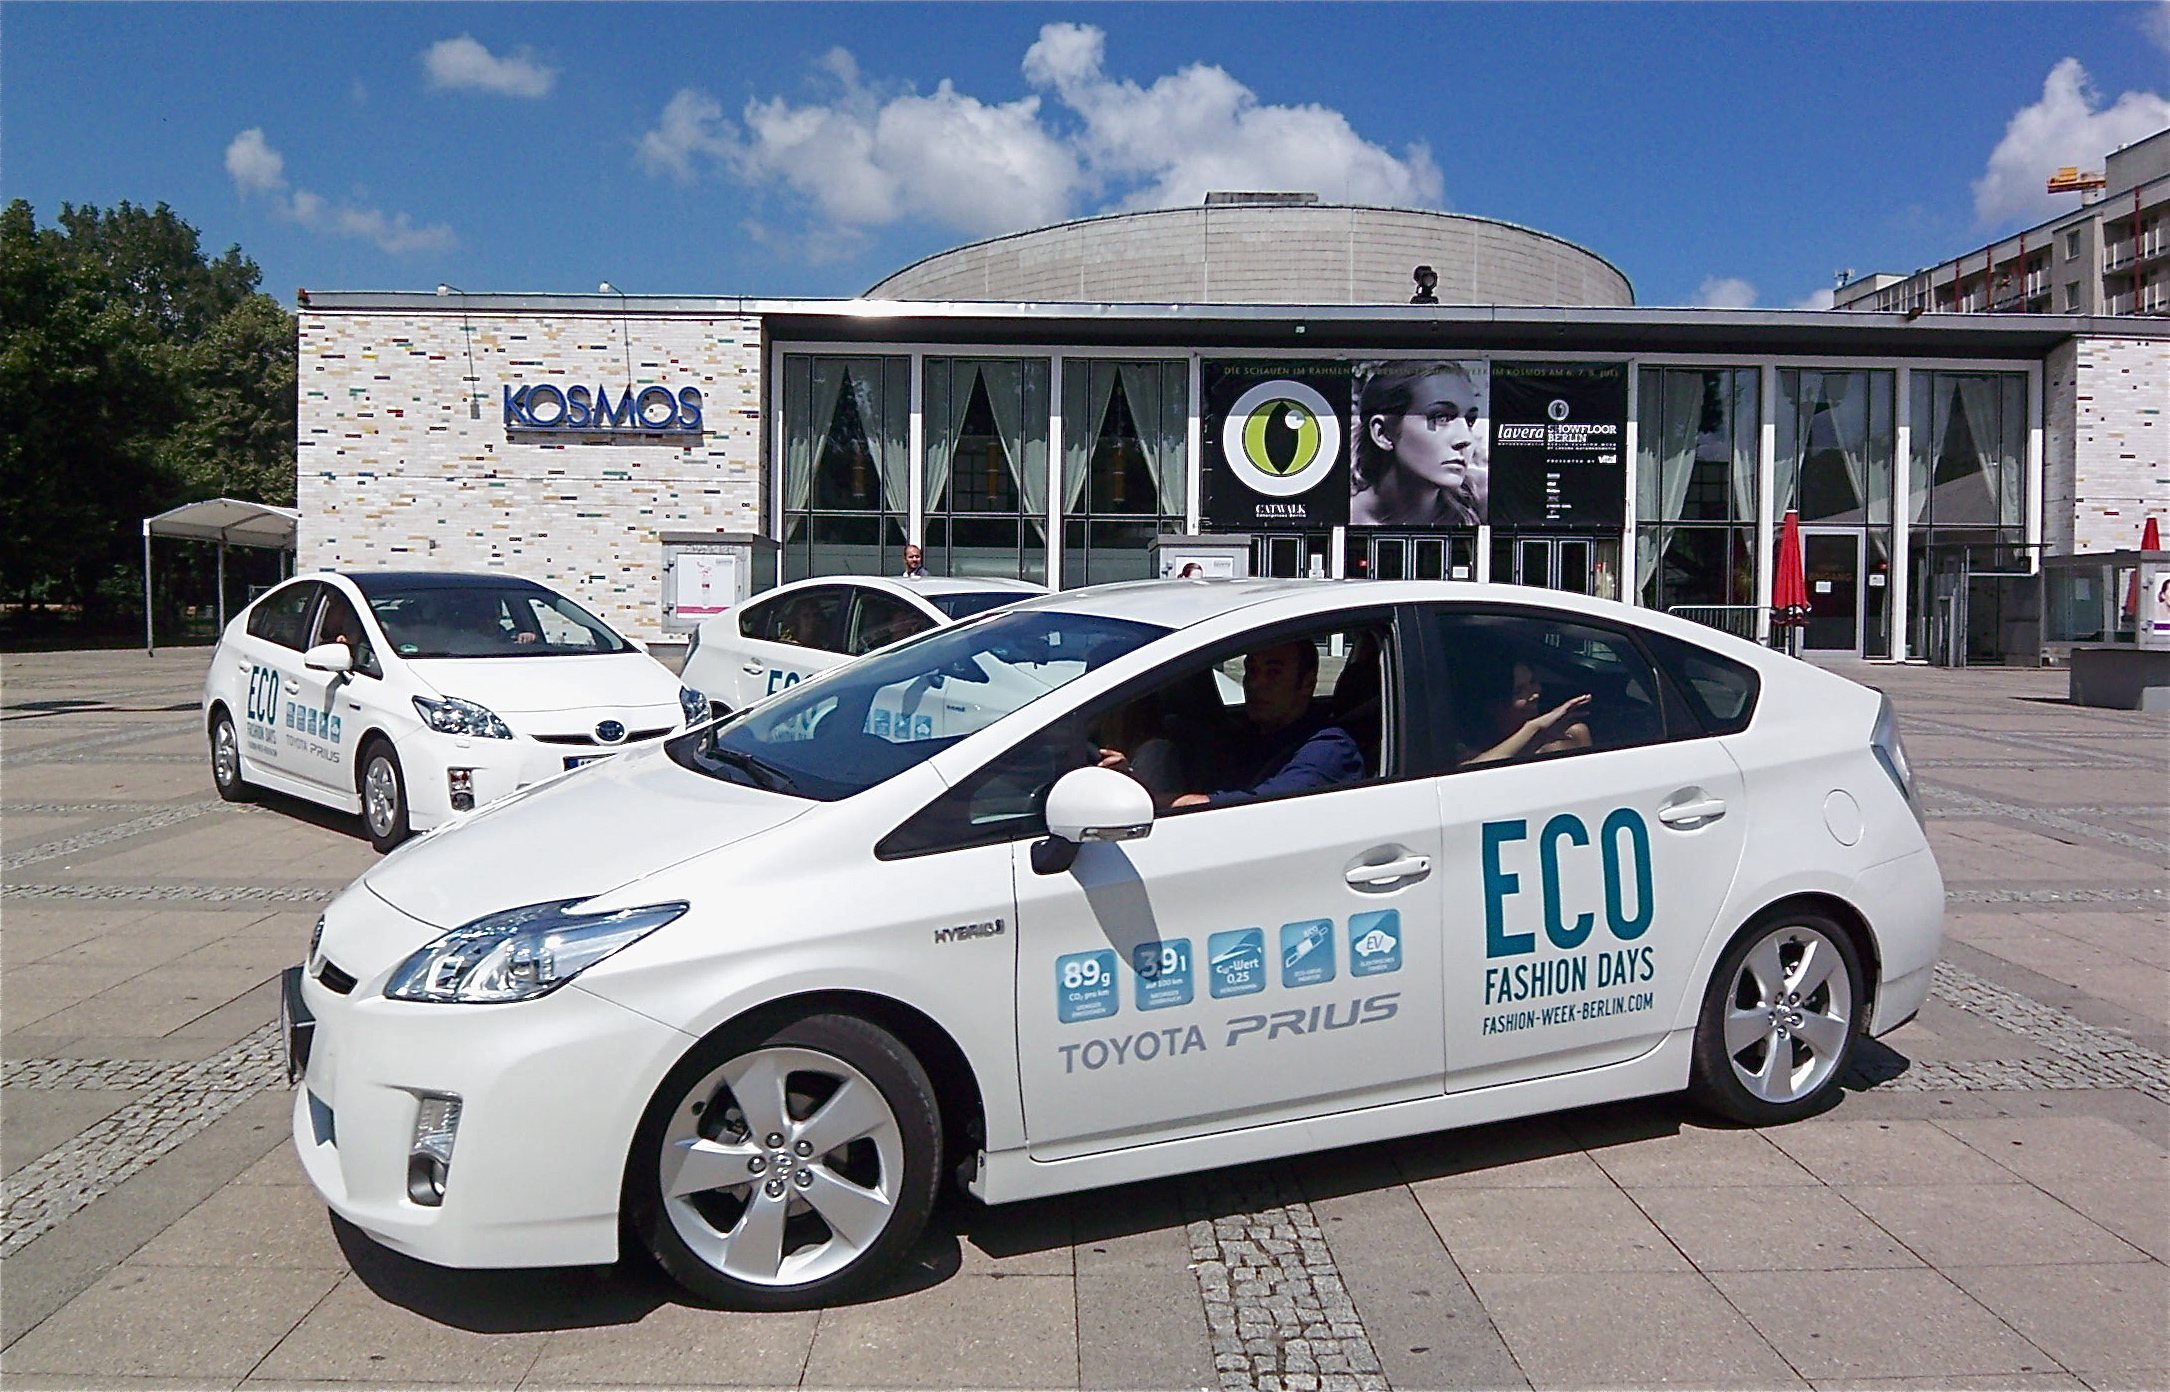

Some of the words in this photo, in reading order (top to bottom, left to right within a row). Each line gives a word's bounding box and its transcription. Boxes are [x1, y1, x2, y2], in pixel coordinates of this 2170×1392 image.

[1224, 366, 1239, 375] DIE
[1244, 366, 1289, 375] SCHAUEN
[1293, 366, 1305, 375] IM
[1309, 366, 1350, 375] RAHMEN
[1507, 367, 1546, 377] KOSMOS
[503, 383, 703, 428] KOSMOS
[1498, 423, 1545, 439] lavera
[1547, 424, 1617, 435] SHOWFLOOR
[1547, 434, 1588, 442] BERLIN
[1255, 503, 1306, 514] CATWALK
[247, 665, 280, 726] ECO
[309, 742, 341, 764] PRIUS
[1481, 807, 1655, 960] ECO
[1366, 935, 1385, 950] EV
[1226, 970, 1250, 985] 0,25
[1484, 955, 1587, 1006] FASHION
[1597, 946, 1655, 989] DAYS
[1482, 992, 1654, 1036] FASHION-WEEK-BERLIN.COM
[1058, 1024, 1208, 1074] TOYOTA
[1226, 991, 1402, 1047] PRIUS
